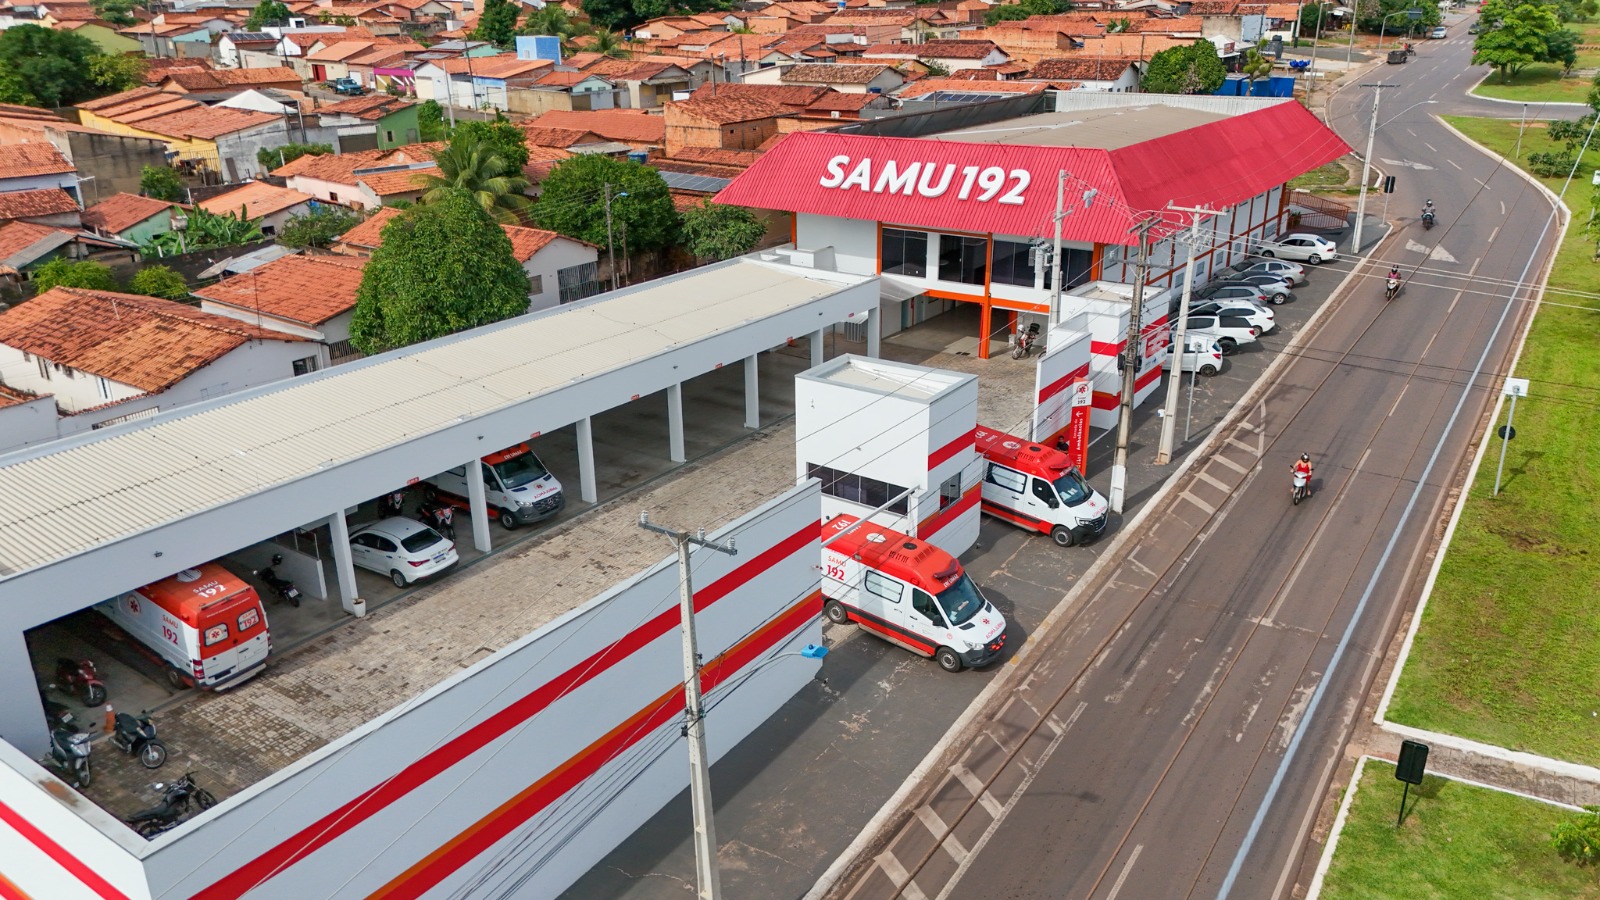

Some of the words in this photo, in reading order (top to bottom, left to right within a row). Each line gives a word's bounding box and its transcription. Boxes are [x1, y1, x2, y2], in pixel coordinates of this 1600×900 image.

[819, 155, 956, 198] SAMU
[957, 166, 1031, 205] 192
[827, 555, 847, 568] SAMU
[827, 564, 845, 581] 192
[193, 580, 218, 593] SAMU
[198, 584, 227, 598] 192
[162, 614, 179, 629] SAMU
[243, 616, 257, 628] 192
[162, 625, 178, 645] 192
